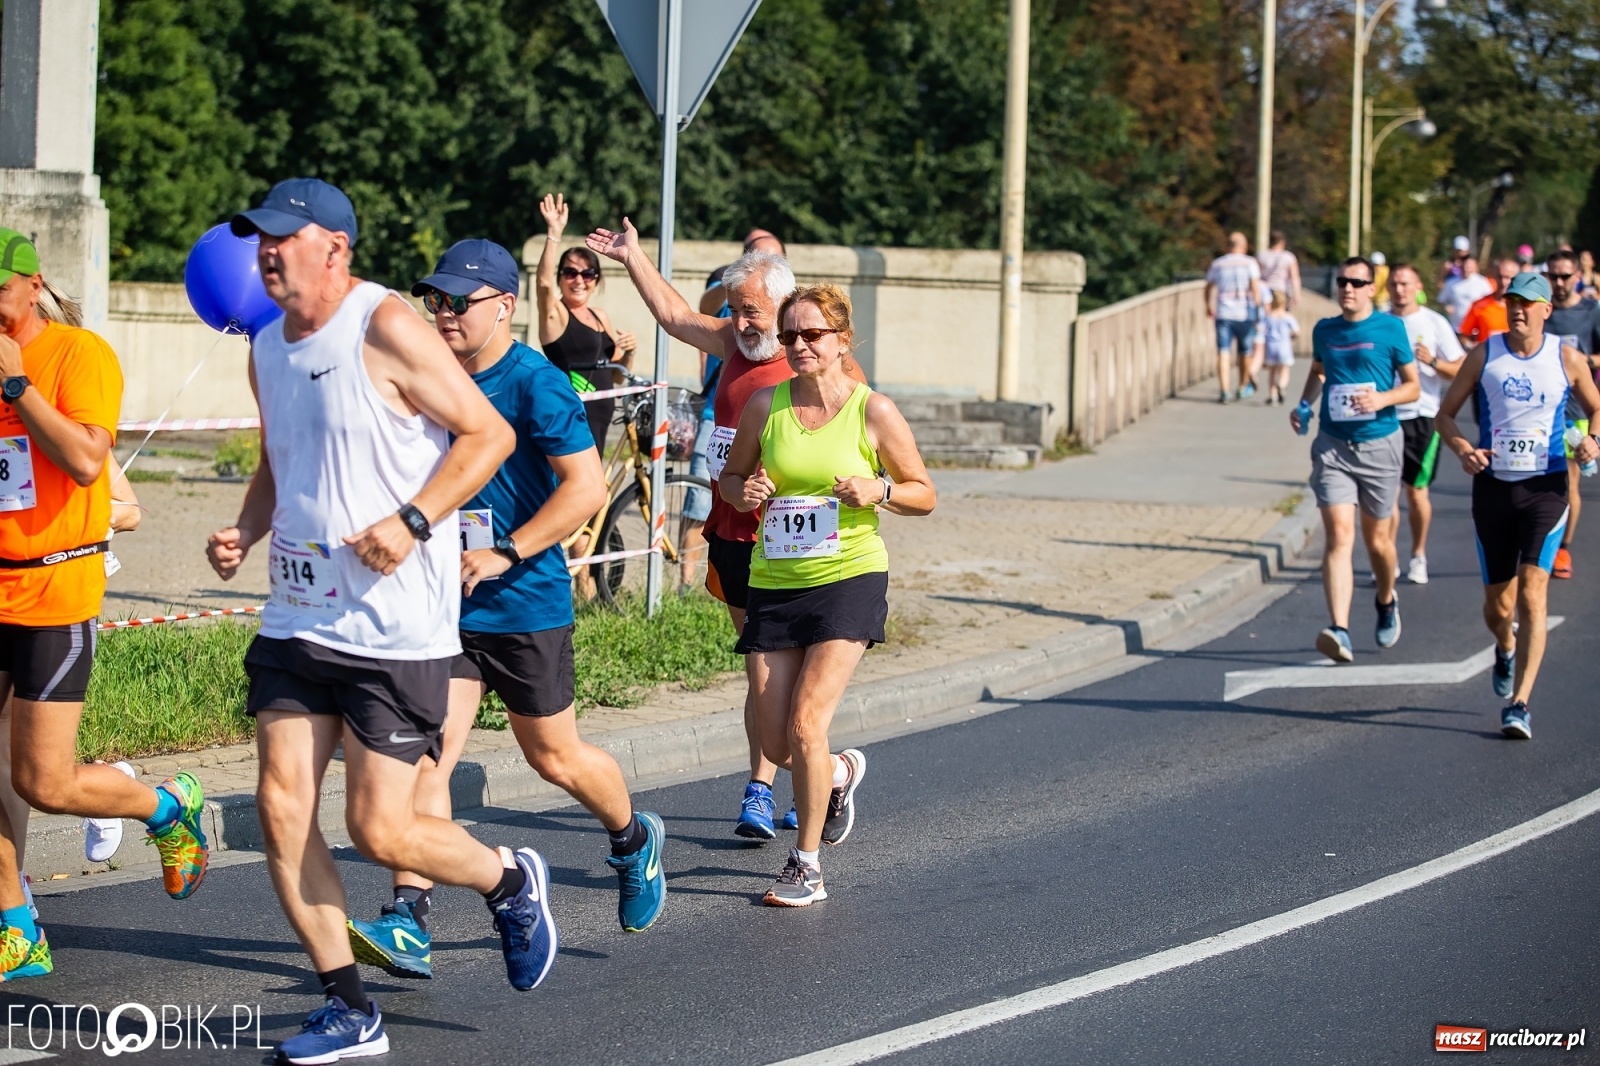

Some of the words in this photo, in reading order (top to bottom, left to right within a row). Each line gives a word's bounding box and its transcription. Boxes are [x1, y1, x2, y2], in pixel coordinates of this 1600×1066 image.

[1508, 440, 1535, 453] 297
[783, 512, 817, 534] 191
[281, 556, 316, 586] 314
